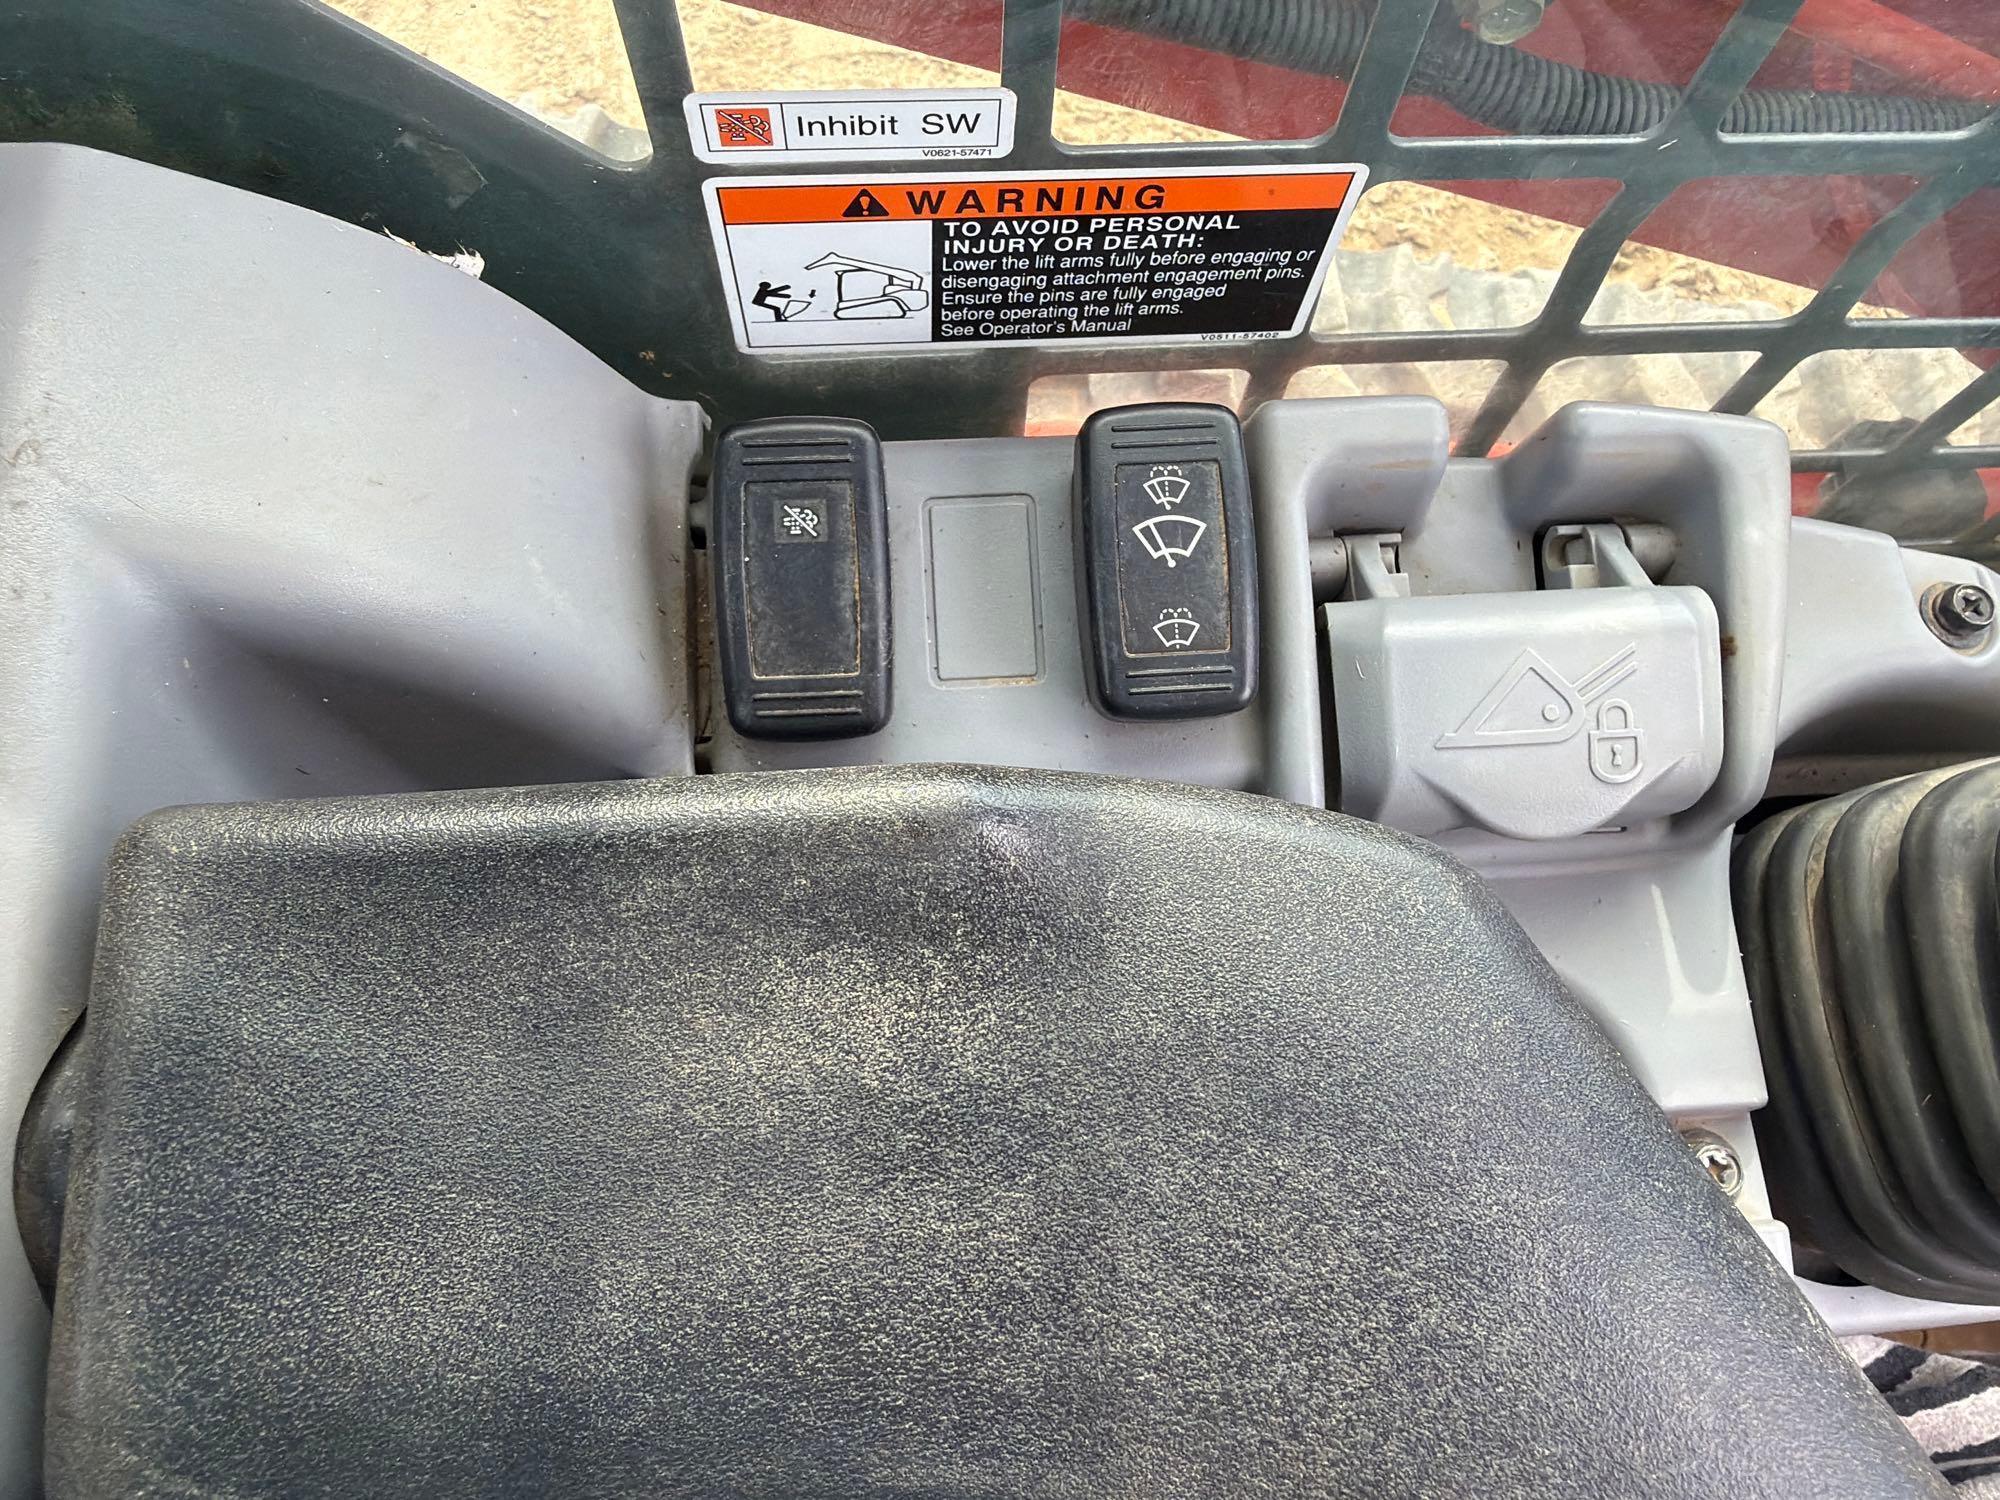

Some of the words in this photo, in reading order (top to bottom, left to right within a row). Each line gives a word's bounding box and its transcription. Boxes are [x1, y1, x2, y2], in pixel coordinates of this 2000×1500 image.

[797, 114, 899, 137] Inhibit
[921, 112, 981, 135] SW
[922, 148, 992, 157] V0621-57471
[905, 184, 1166, 215] WARNING
[943, 221, 981, 237] TO
[991, 218, 1080, 236] AVOID
[1089, 214, 1241, 232] PERSONAL
[944, 238, 1045, 254] INJURY
[1054, 236, 1092, 251] OR
[1103, 234, 1204, 250] DEATH:
[942, 257, 996, 272] Lower
[1001, 254, 1029, 270] the
[1035, 254, 1055, 268] lift
[1061, 255, 1104, 269] arms
[1109, 250, 1145, 269] fully
[1150, 248, 1206, 266] before
[1210, 247, 1292, 266] engaging
[1296, 249, 1315, 261] or
[941, 273, 1047, 290] disengaging
[1053, 269, 1149, 286] attachment
[1154, 266, 1261, 284] engagement
[1265, 264, 1305, 281] pins.
[942, 290, 1002, 305] Ensure
[1008, 289, 1036, 303] the
[1039, 287, 1075, 304] pins
[1080, 287, 1107, 301] are
[1112, 284, 1147, 303] fully
[1151, 284, 1227, 301] engaged
[941, 307, 995, 322] before
[1000, 303, 1079, 321] operating
[1083, 302, 1110, 317] the
[1114, 300, 1134, 316] lift
[1138, 301, 1184, 316] arms.
[941, 324, 974, 337] See
[979, 321, 1066, 338] Operator's
[1071, 317, 1132, 332] Manual
